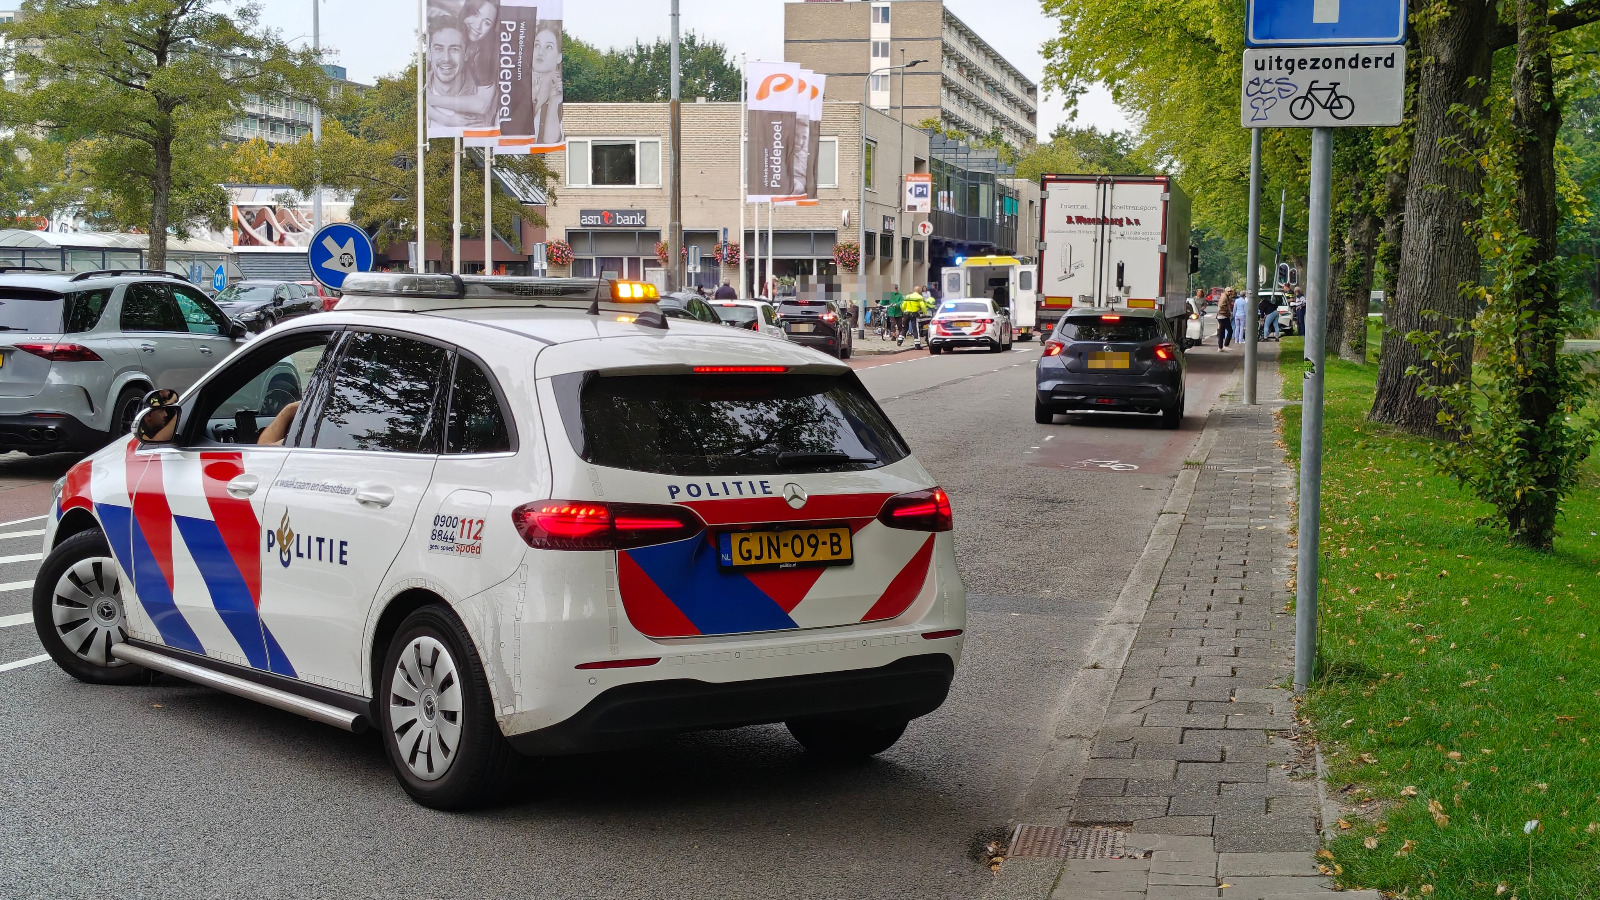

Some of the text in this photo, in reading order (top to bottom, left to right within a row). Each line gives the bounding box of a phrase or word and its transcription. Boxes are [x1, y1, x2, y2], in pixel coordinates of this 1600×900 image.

[518, 21, 527, 80] winkelcentrum
[499, 20, 517, 122] Paddepoel
[1254, 52, 1395, 75] uitgezonderd
[769, 120, 785, 188] Paddepoel
[916, 187, 927, 195] P1
[580, 213, 645, 225] asn bank
[667, 480, 773, 499] POLITIE
[430, 528, 455, 543] 8844
[433, 514, 485, 540] 0900 112
[267, 529, 348, 568] POLITIE
[455, 542, 482, 555] spoed
[721, 532, 843, 561] NL GJN-09-B
